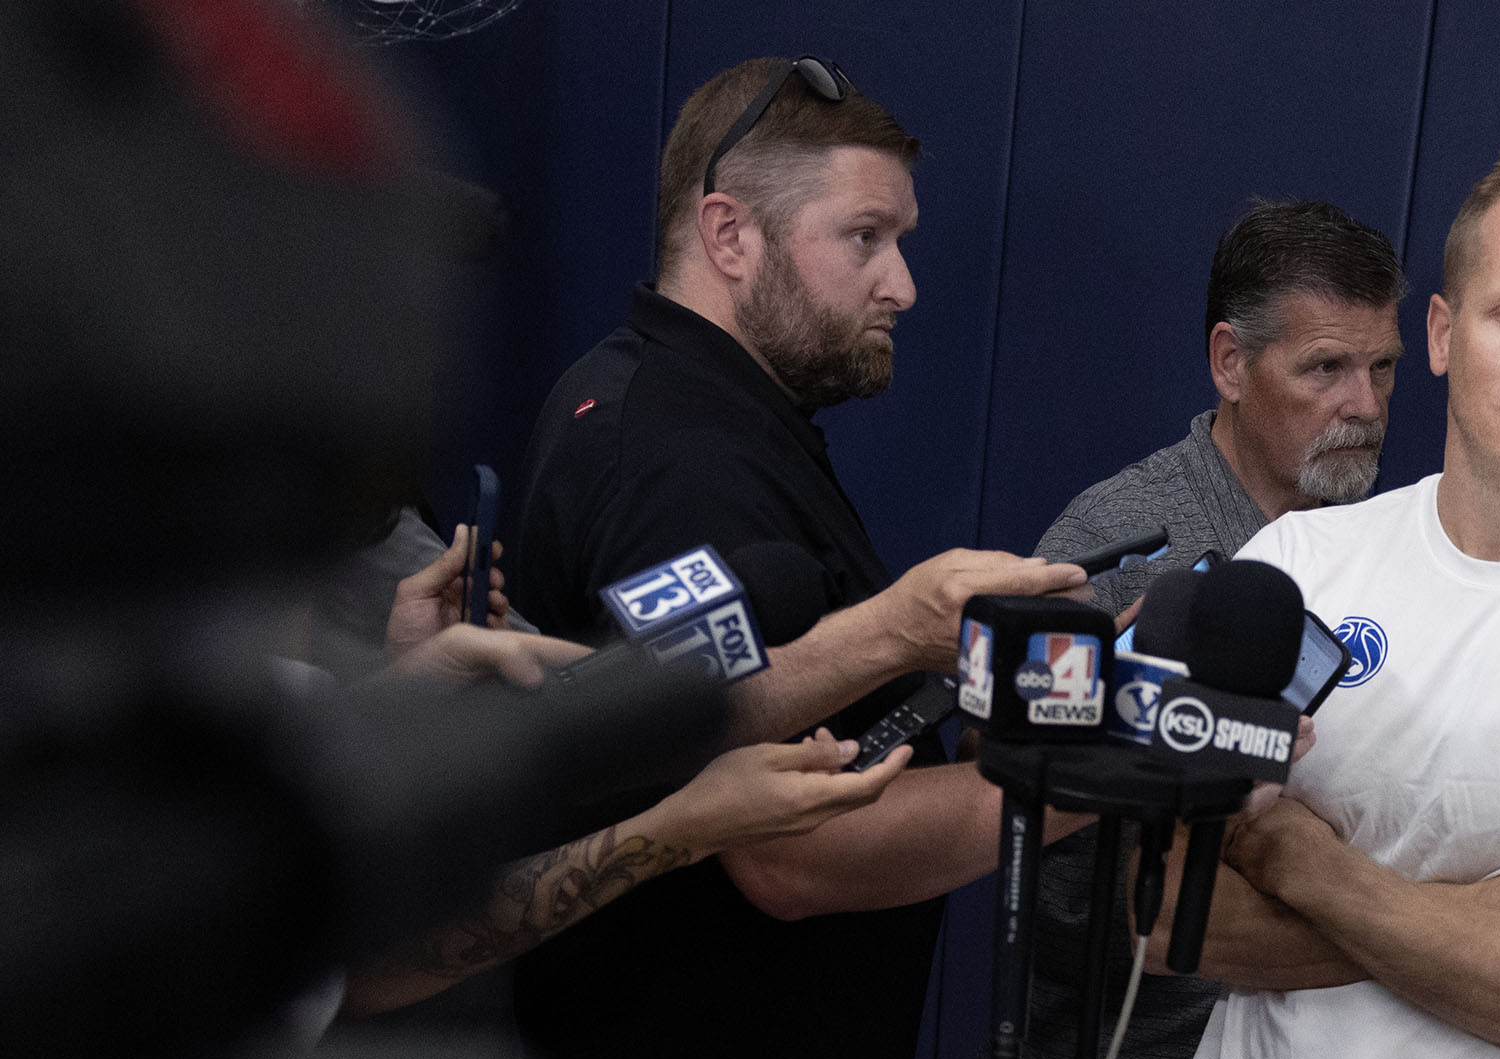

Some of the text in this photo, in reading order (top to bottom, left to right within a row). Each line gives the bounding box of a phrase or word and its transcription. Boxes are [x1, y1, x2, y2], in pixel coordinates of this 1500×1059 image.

[616, 573, 691, 621] 13
[681, 560, 723, 595] FOX
[714, 613, 753, 670] FOX
[1016, 670, 1054, 689] abc
[1048, 643, 1094, 701] 4
[1033, 703, 1098, 722] NEWS
[1166, 710, 1293, 763] KSL SPORTS
